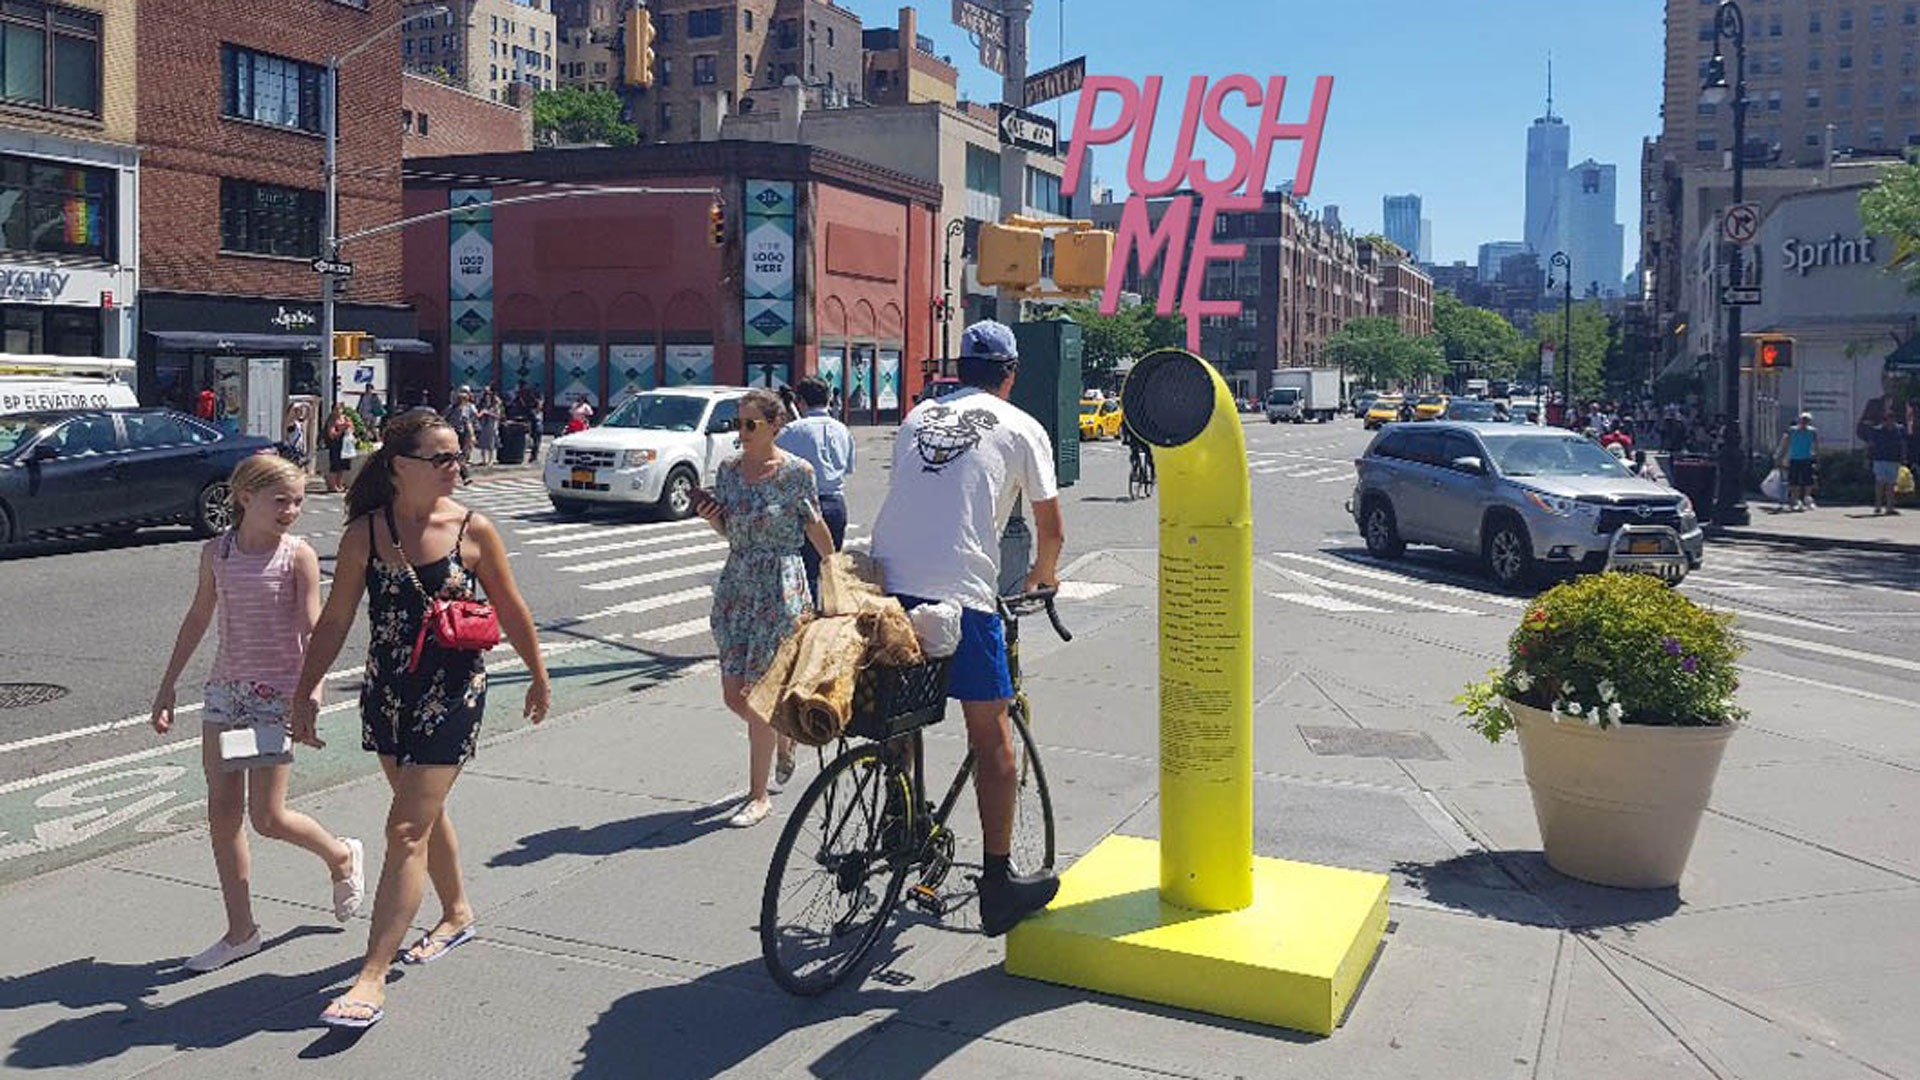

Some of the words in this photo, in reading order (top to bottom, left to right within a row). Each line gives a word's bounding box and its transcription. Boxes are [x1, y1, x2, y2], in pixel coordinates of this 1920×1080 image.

[1060, 74, 1334, 197] PUSH
[459, 255, 484, 265] LOGO
[753, 252, 785, 262] LOGO
[1100, 194, 1263, 317] ME
[1782, 234, 1876, 276] Sprint
[755, 264, 782, 273] HERE
[3, 395, 20, 410] BP
[24, 394, 88, 409] ELEVATOR
[90, 394, 108, 409] CO
